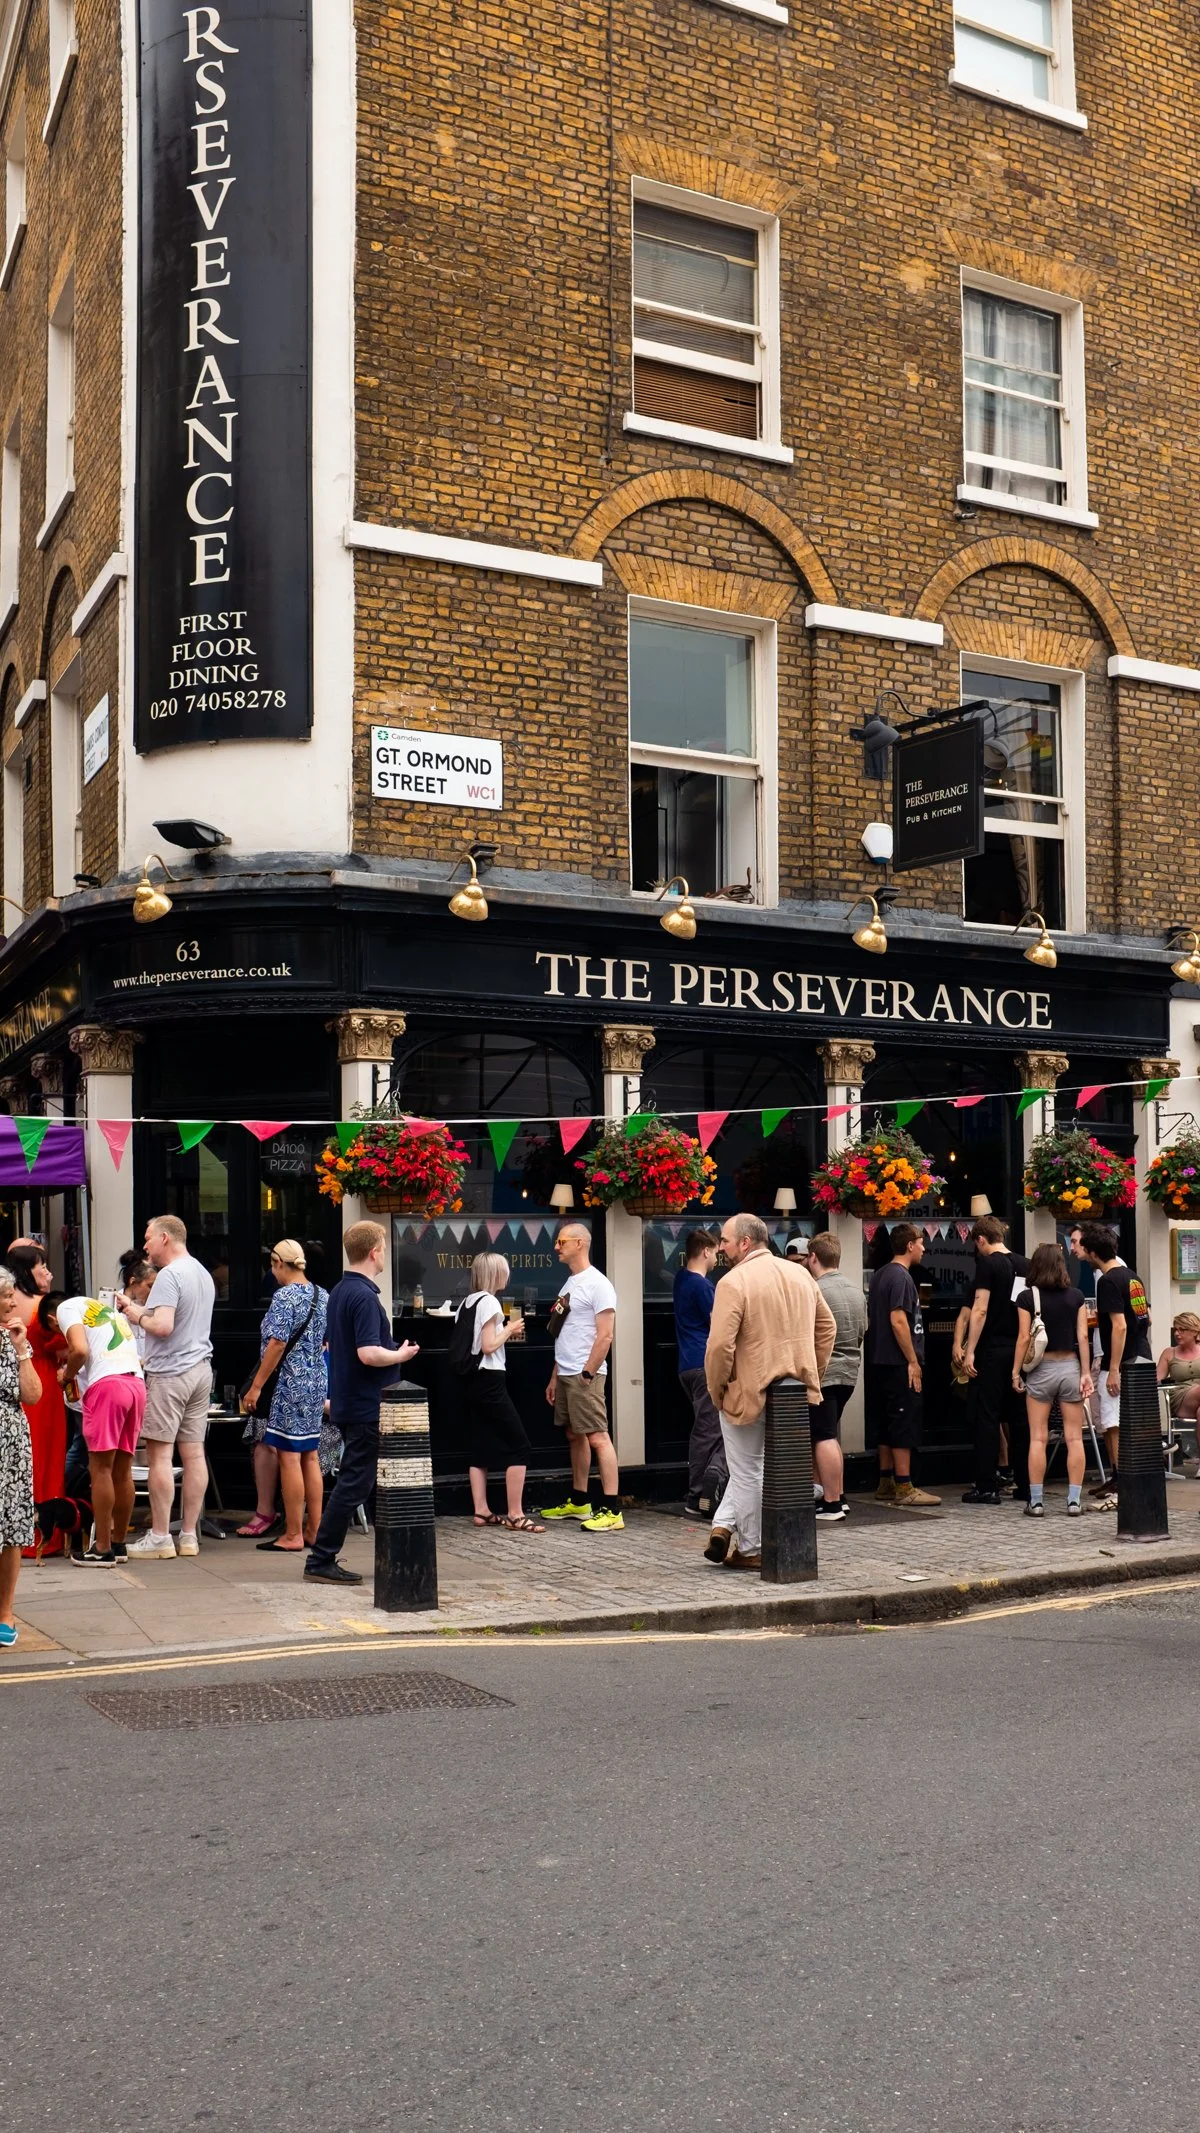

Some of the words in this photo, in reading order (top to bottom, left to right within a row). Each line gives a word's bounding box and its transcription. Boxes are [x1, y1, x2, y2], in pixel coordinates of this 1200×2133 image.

[179, 611, 247, 635] FIRST
[172, 638, 256, 662] FLOOR
[169, 664, 260, 689] DINING
[151, 698, 178, 719] 020
[185, 690, 287, 712] 74058278
[391, 733, 422, 742] Camden
[376, 747, 401, 765] GT.
[407, 750, 492, 775] ORMOND
[377, 772, 447, 794] STREET
[467, 785, 496, 800] WC1
[905, 780, 923, 793] THE
[905, 783, 969, 808] PERSEVERANCE
[923, 812, 929, 821] &
[176, 940, 200, 962] 63
[113, 963, 292, 988] www.theperseverance.co.uk
[536, 952, 651, 1002] THE
[670, 963, 1053, 1029] PERSEVERANCE
[270, 1159, 305, 1171] PIZZA
[437, 1253, 473, 1269] WINE
